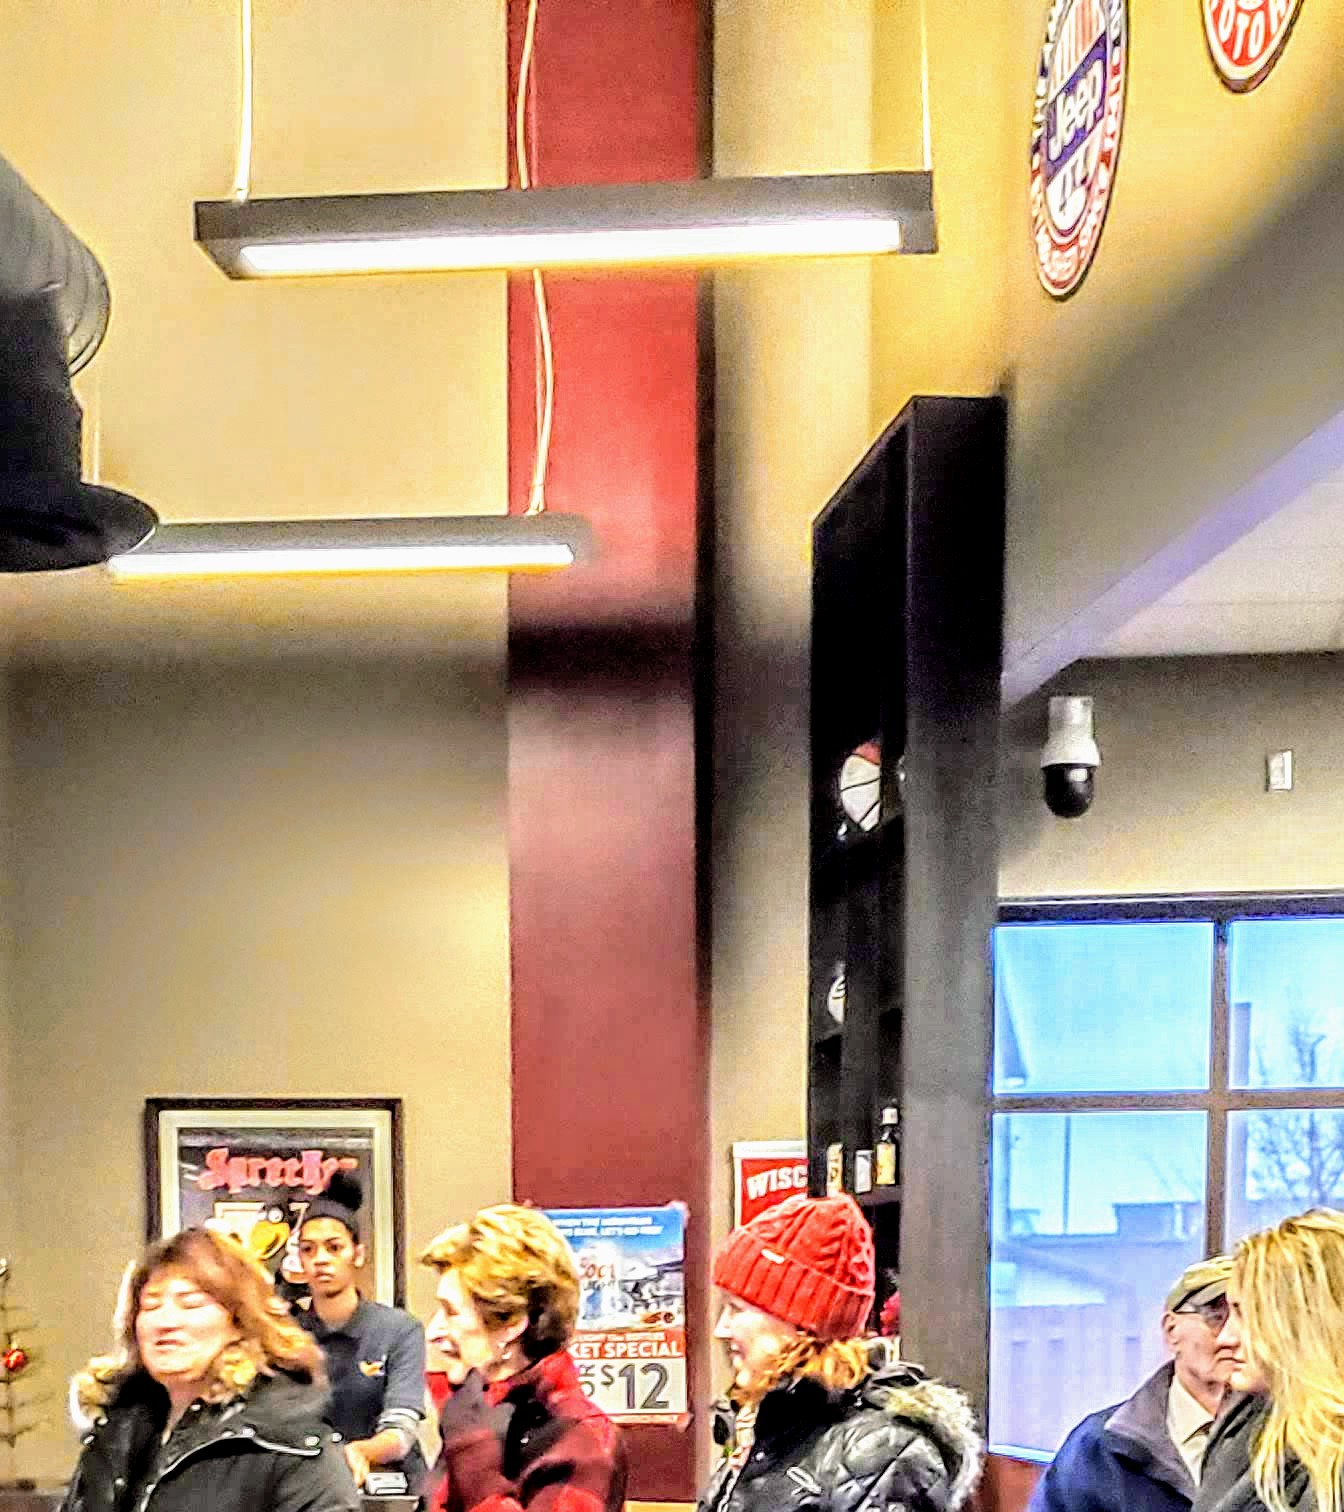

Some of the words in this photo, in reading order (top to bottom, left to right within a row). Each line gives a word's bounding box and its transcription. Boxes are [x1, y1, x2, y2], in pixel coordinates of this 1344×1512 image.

[1047, 58, 1104, 164] Jeep
[747, 1165, 807, 1200] WISC
[604, 1340, 682, 1358] SPECIAL
